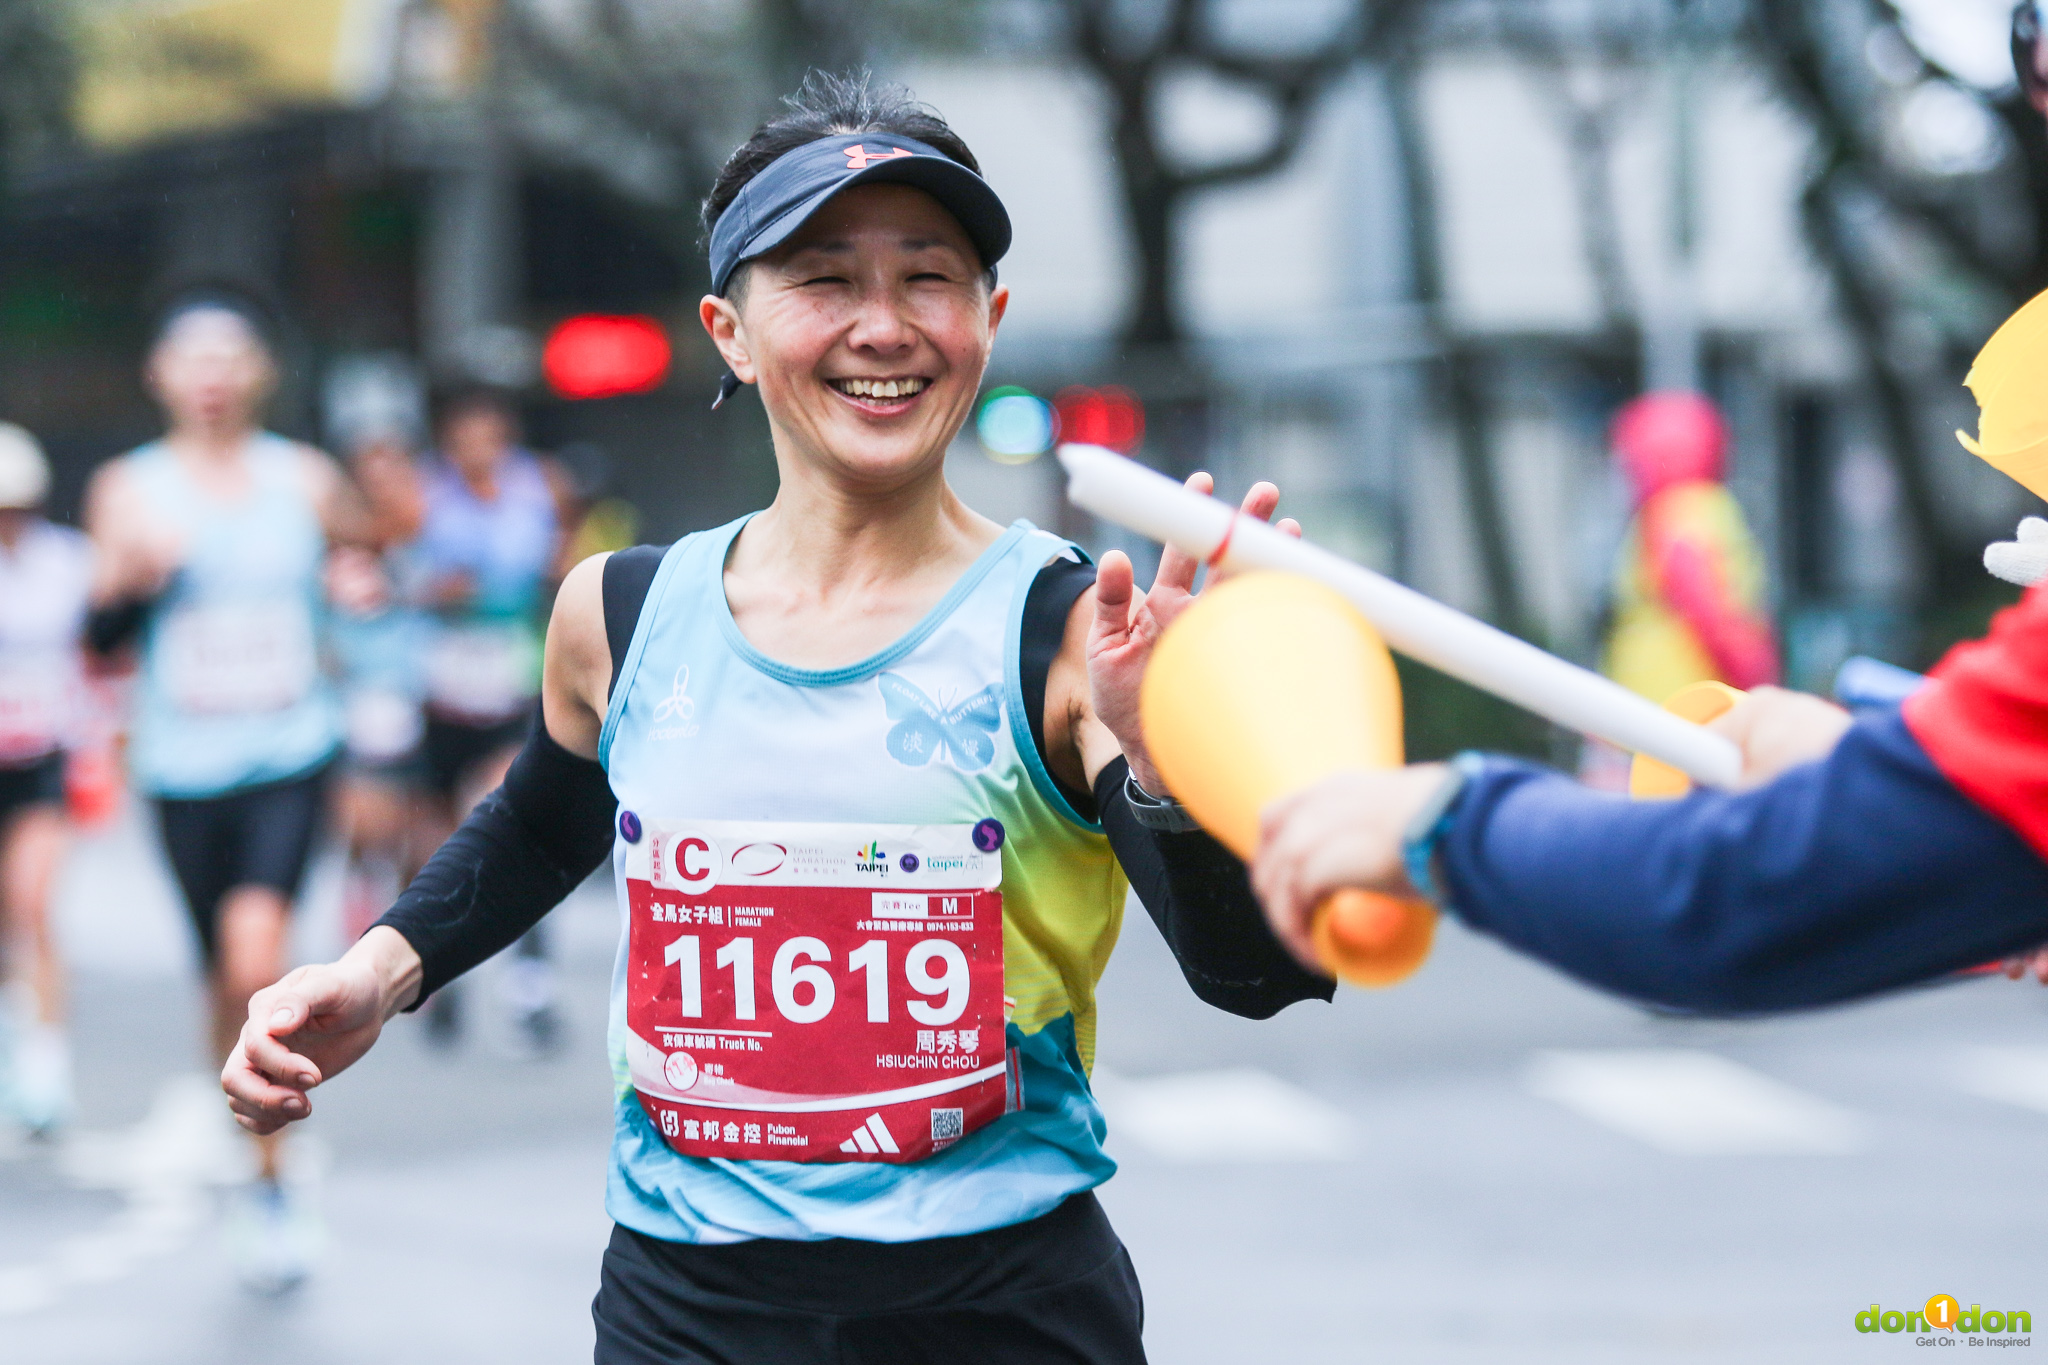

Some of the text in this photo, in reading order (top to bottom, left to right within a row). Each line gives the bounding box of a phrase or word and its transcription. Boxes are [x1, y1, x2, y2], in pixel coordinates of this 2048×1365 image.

[675, 837, 710, 881] C
[927, 856, 963, 872] taipei
[855, 862, 889, 874] TAIPEI
[651, 902, 724, 926] 全馬女子組
[734, 906, 774, 917] MARATHON
[942, 897, 958, 915] M
[734, 917, 762, 927] FEMALE
[664, 935, 970, 1026] 11619
[719, 1036, 746, 1051] Truck
[747, 1038, 764, 1052] No.
[916, 1029, 980, 1054] 周秀琴
[876, 1054, 980, 1070] HSIUCHIN CHOU
[684, 1118, 761, 1144] 富邦金控
[767, 1123, 796, 1135] Fubon
[767, 1134, 809, 1147] Financial
